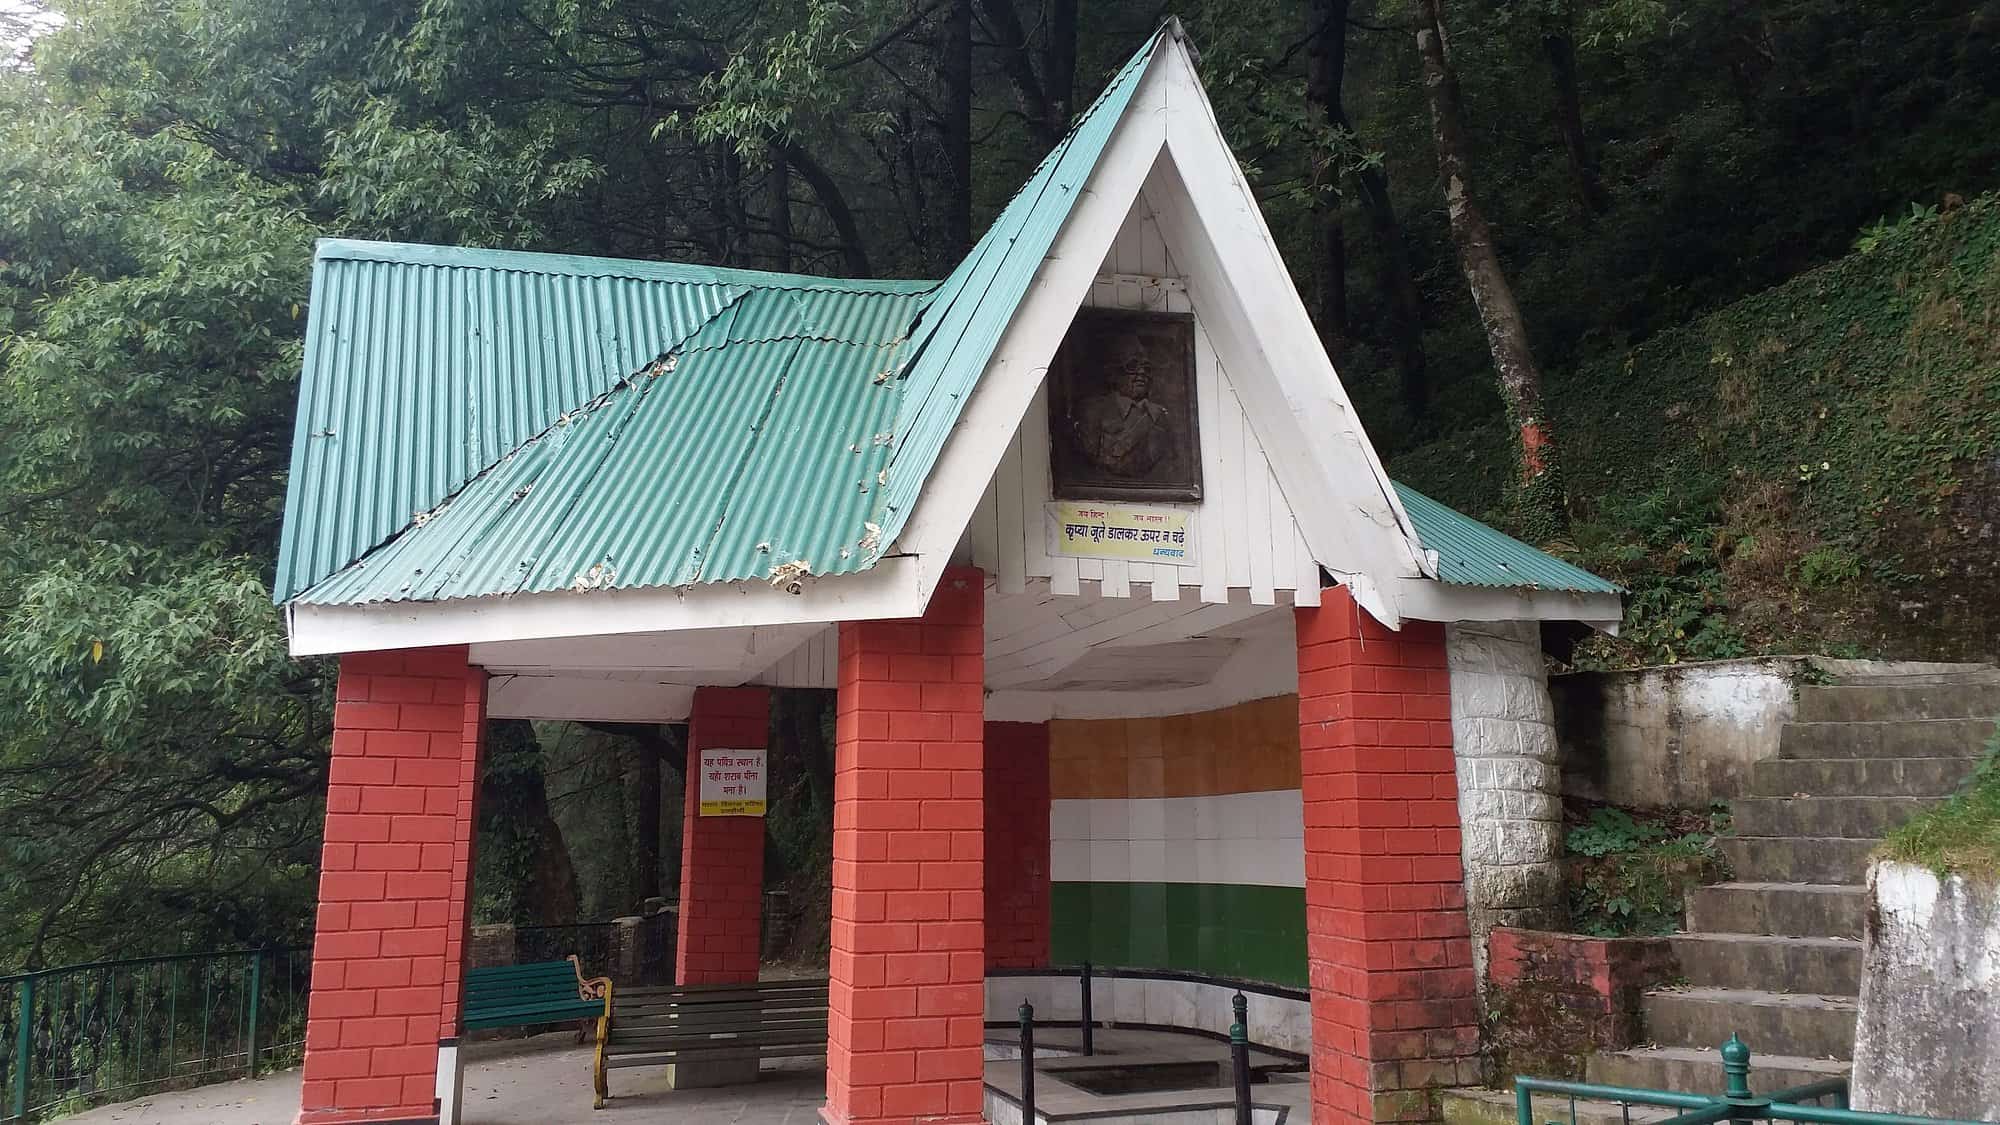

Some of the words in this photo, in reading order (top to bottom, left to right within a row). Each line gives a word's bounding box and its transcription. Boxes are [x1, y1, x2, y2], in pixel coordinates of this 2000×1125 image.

[1090, 521, 1106, 543] जूते
[1108, 527, 1138, 541] डालकर
[1140, 529, 1160, 543] ऊपर
[1163, 531, 1171, 542] न
[1153, 548, 1185, 558] धन्यवाद
[704, 758, 715, 767] यह
[724, 772, 741, 781] शराब
[744, 770, 758, 781] पीना
[723, 786, 736, 795] मना
